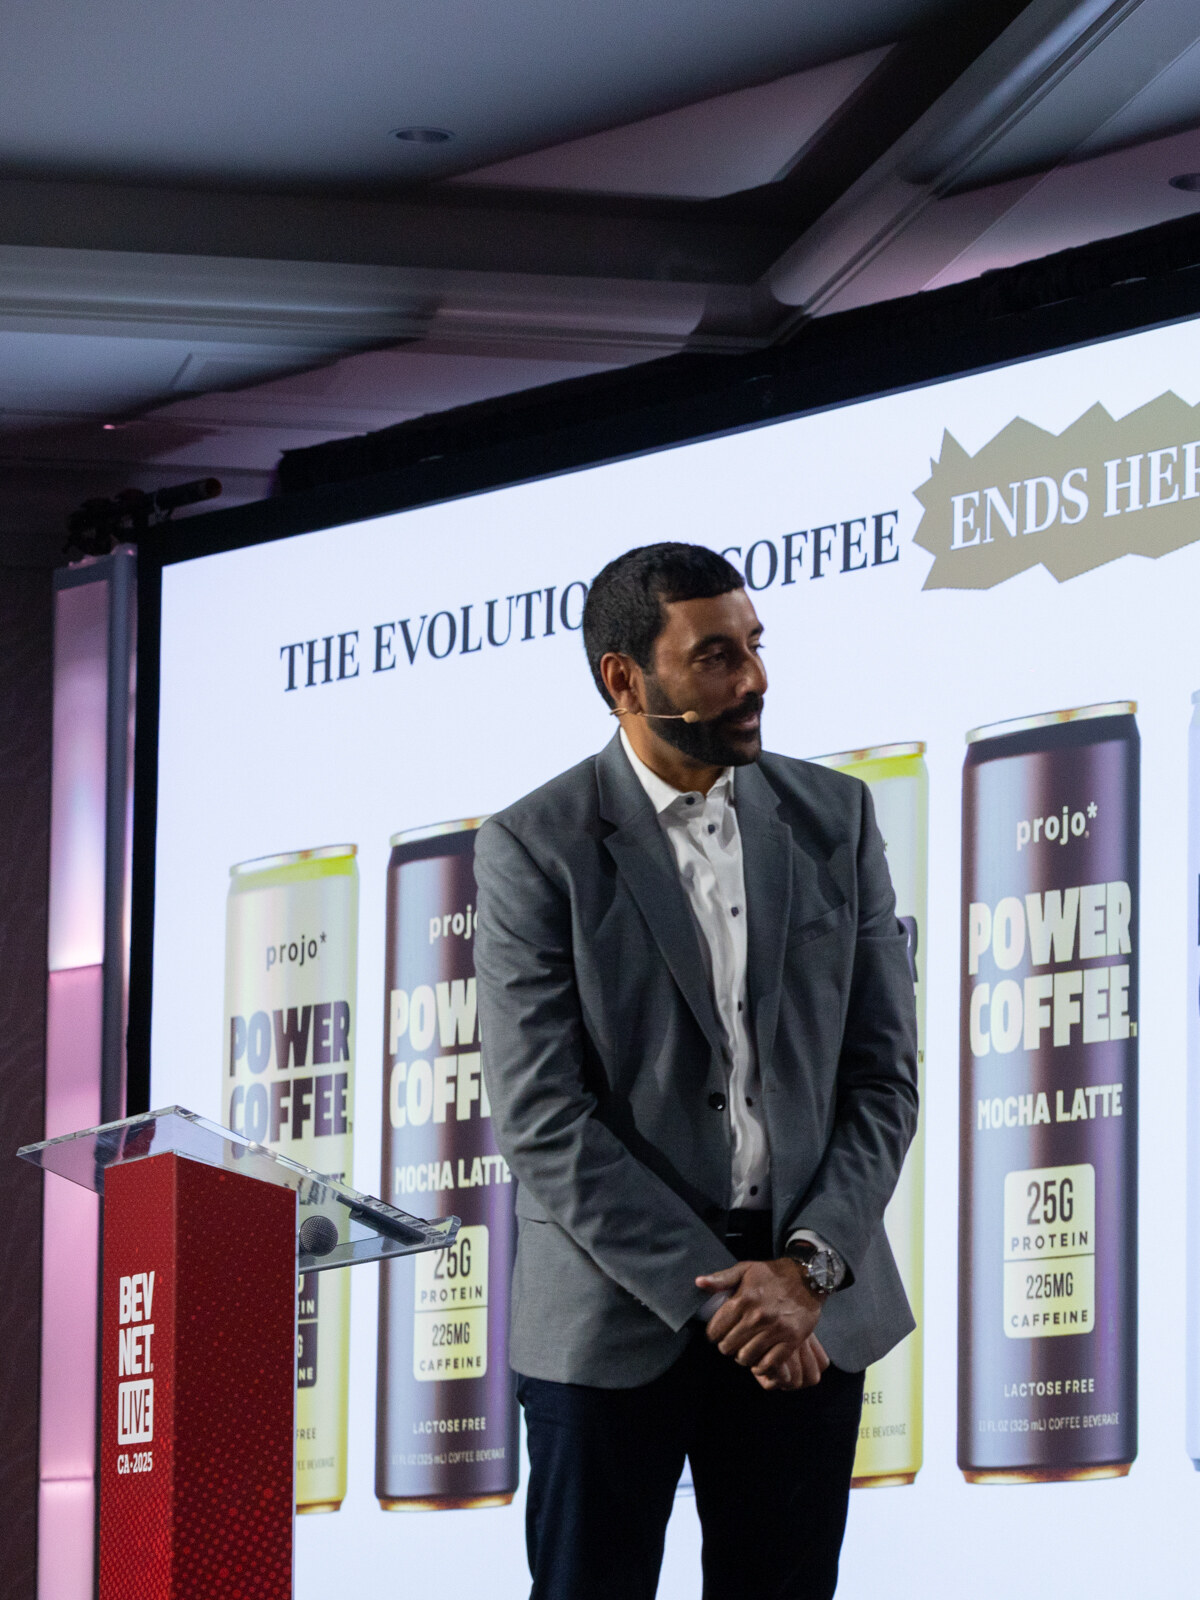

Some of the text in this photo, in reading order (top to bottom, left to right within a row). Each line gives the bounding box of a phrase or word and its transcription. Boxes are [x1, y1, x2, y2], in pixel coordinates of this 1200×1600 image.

[950, 467, 1090, 550] ENDS
[280, 631, 360, 692] THE
[372, 581, 590, 673] EVOLUTIO
[429, 904, 478, 945] proj
[968, 880, 1132, 976] POWER
[389, 976, 482, 1056] POW
[229, 1000, 350, 1078] POWER
[389, 1051, 492, 1130] COFF
[977, 1083, 1123, 1131] MOCHA LATTE
[394, 1160, 454, 1195] MOCHA
[1026, 1177, 1074, 1226] 25G
[433, 1237, 472, 1280] 25G
[1011, 1231, 1089, 1252] PROTEIN
[119, 1270, 155, 1325] BEV
[420, 1284, 483, 1304] PROTEIN
[1025, 1272, 1074, 1300] 225MG
[431, 1322, 471, 1348] 225MG
[1010, 1310, 1089, 1328] CAFFEINE
[118, 1324, 155, 1377] NET
[419, 1355, 482, 1372] CAFFEINE
[862, 1391, 884, 1405] REE
[1003, 1378, 1096, 1399] LACTOSE FREE
[121, 1388, 151, 1436] LIVE
[413, 1416, 487, 1434] LACTOSE FREE
[1048, 1416, 1081, 1431] COFFEE
[1082, 1412, 1120, 1428] BEVERAGE
[448, 1449, 475, 1464] COFFEE
